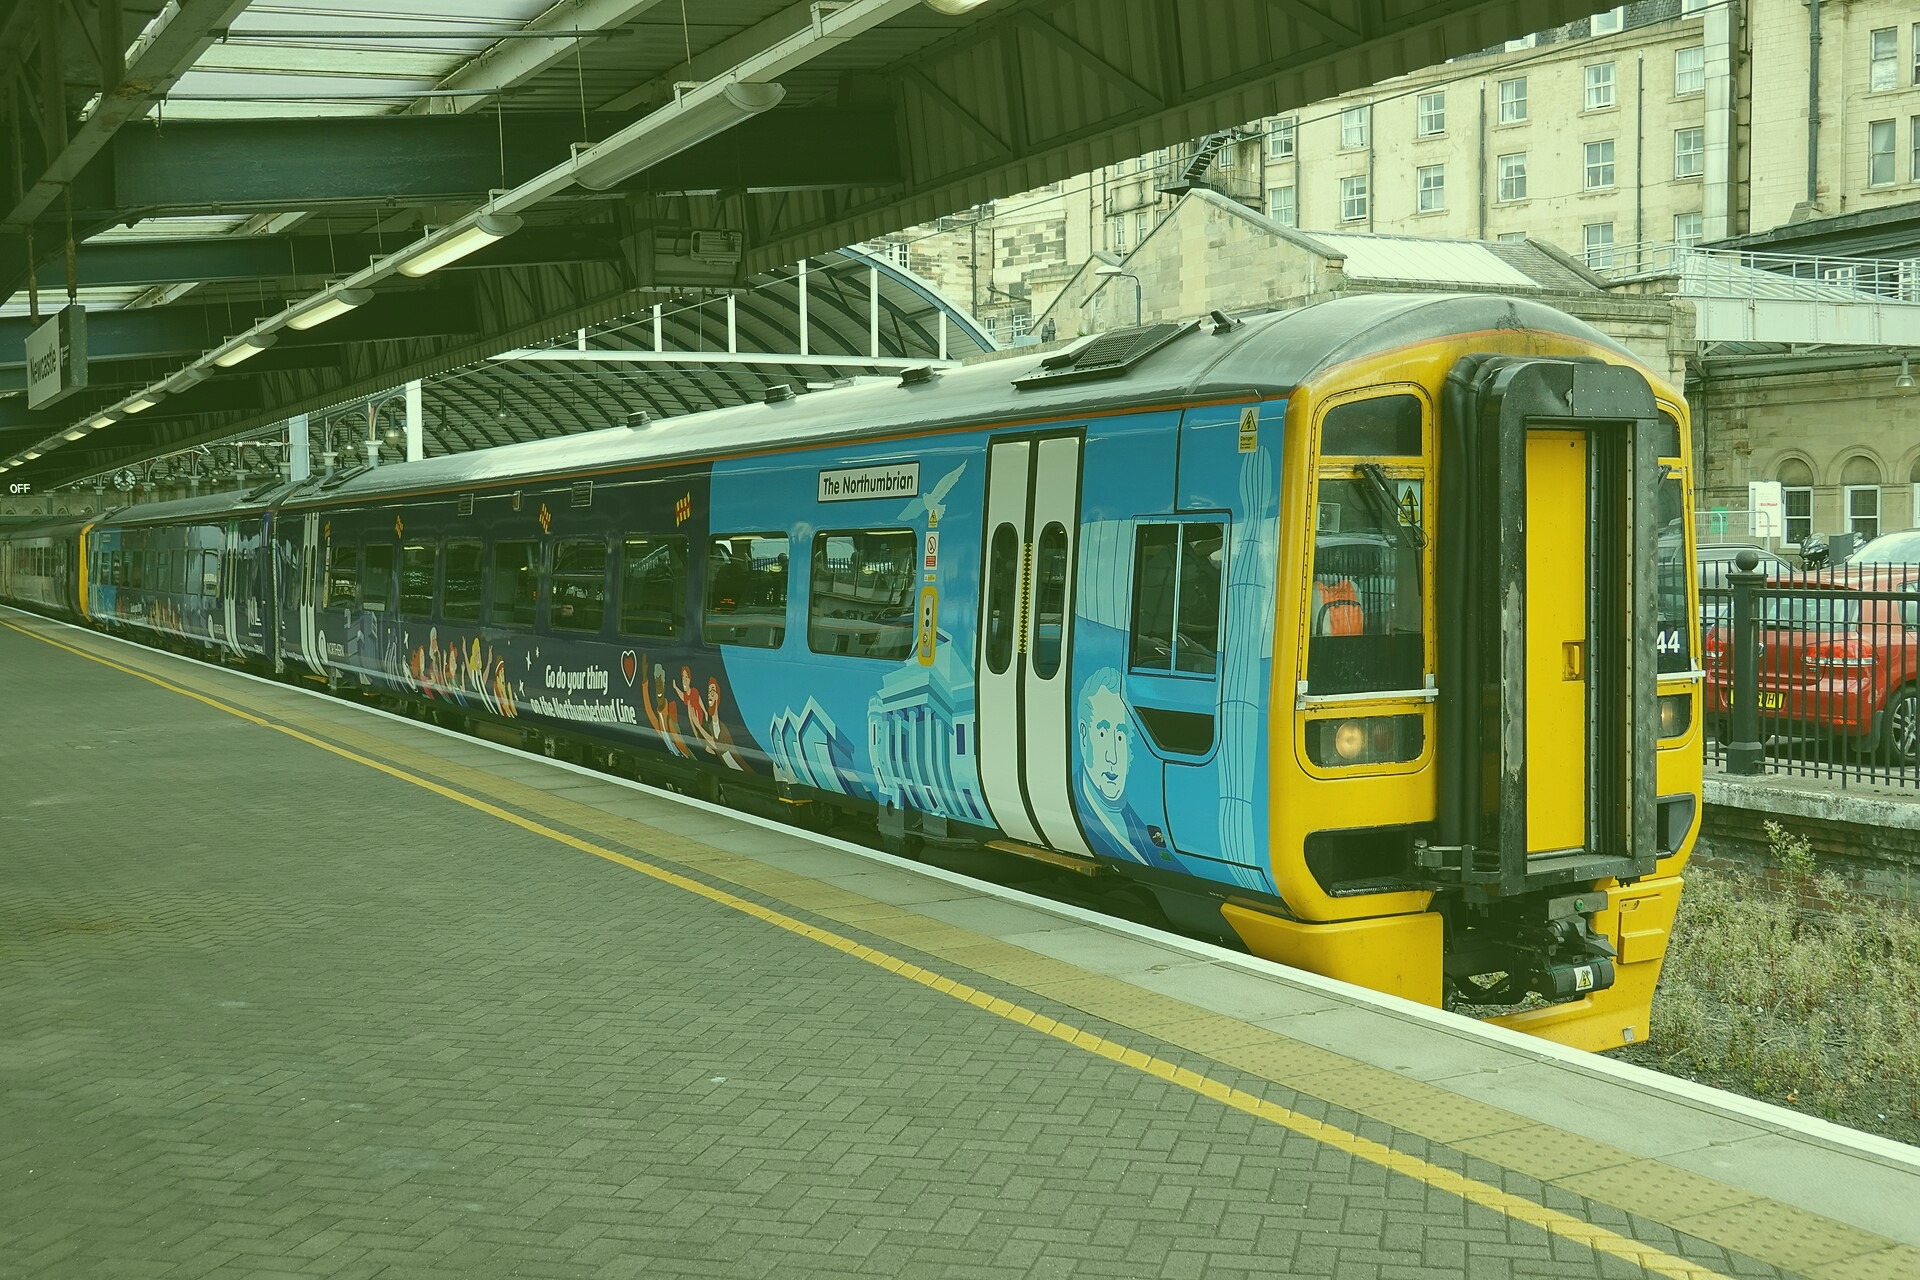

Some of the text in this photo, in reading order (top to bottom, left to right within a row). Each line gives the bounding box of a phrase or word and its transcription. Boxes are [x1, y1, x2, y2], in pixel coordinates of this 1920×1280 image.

[30, 342, 57, 386] Newcastle
[9, 483, 31, 494] OFF
[823, 471, 914, 496] The Northumbrian
[1656, 630, 1681, 654] 44
[545, 664, 609, 696] Go do your thing
[530, 695, 637, 725] on the Northumberland Line
